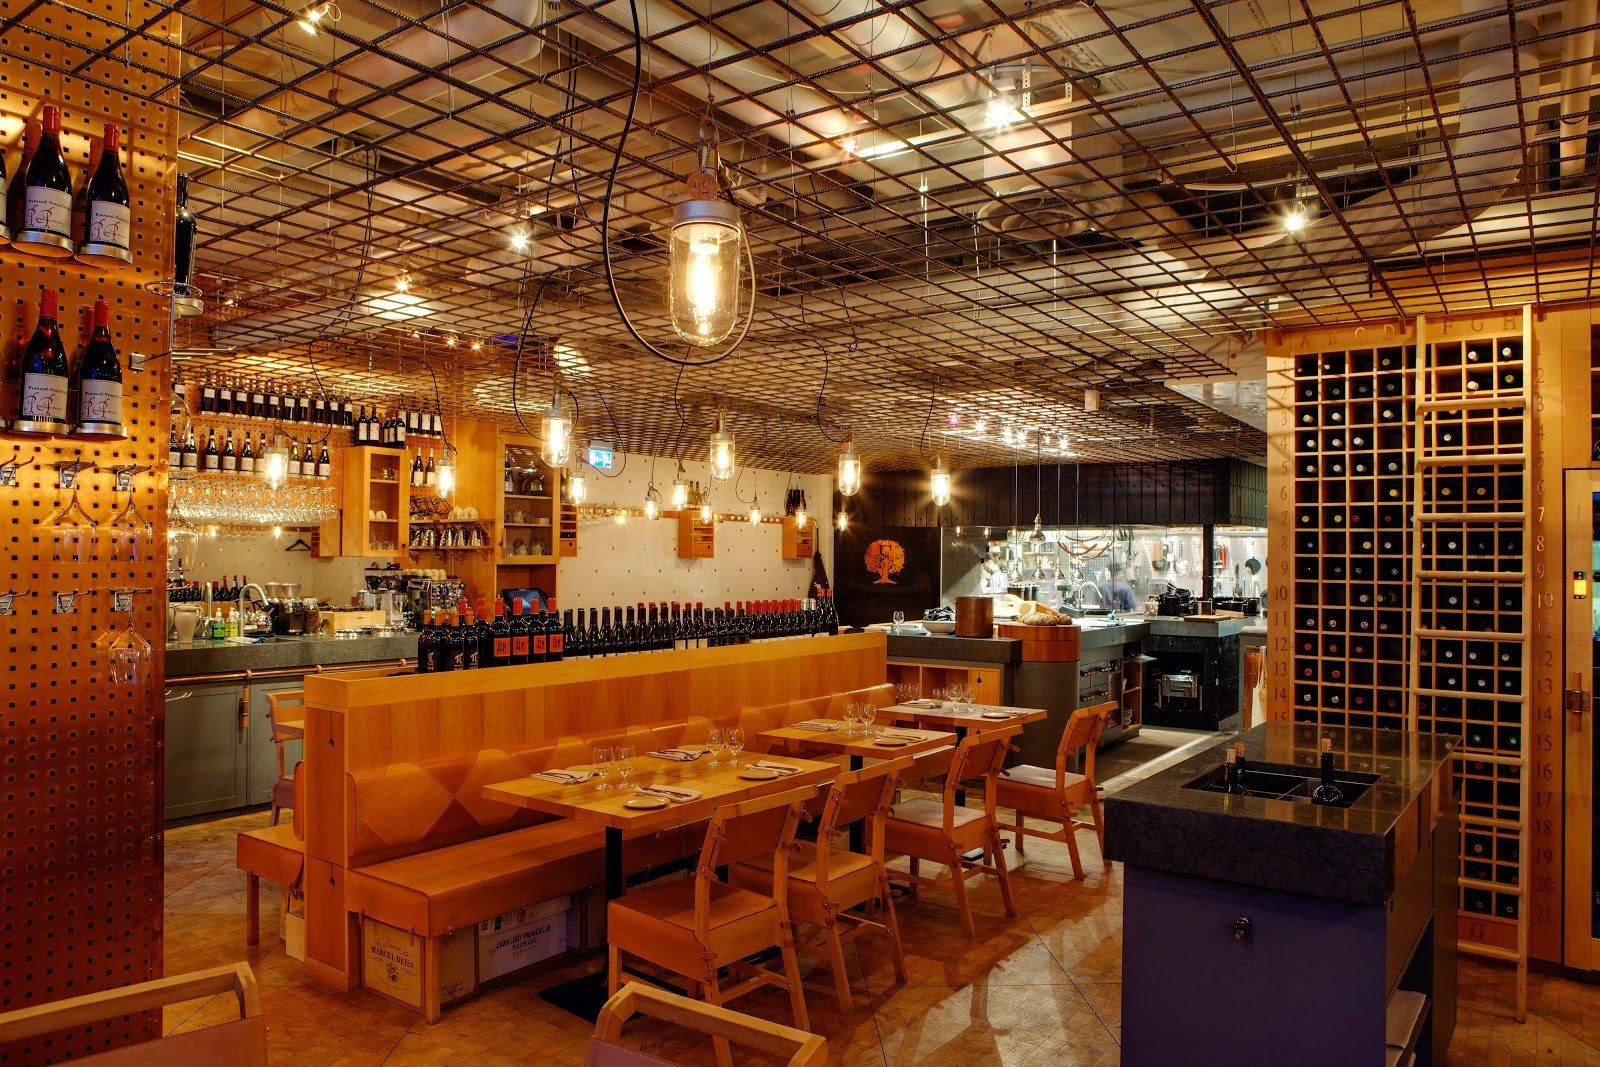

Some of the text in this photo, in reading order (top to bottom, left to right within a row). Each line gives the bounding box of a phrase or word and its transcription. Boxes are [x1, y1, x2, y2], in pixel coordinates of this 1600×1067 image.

[1354, 326, 1367, 343] C
[1383, 324, 1396, 340] D
[1471, 317, 1485, 333] G
[1536, 368, 1545, 384] 2
[1536, 396, 1544, 412] 3
[1281, 411, 1288, 426] 3
[1536, 424, 1545, 440] 4
[1280, 435, 1288, 450] 4
[1280, 460, 1288, 475] 5
[1536, 452, 1545, 468] 5
[1280, 485, 1288, 501] 6
[1536, 480, 1545, 496] 6
[1281, 510, 1288, 526] 7
[1537, 507, 1545, 523] 7
[1281, 535, 1288, 551] 8
[1536, 535, 1545, 552] 8
[1280, 560, 1289, 576] 9
[1537, 563, 1545, 580] 9
[1274, 585, 1288, 601] 10
[1537, 592, 1554, 609] 10
[1274, 611, 1288, 627] 11
[1536, 621, 1553, 639] 11
[1273, 637, 1288, 652] 12
[1536, 650, 1554, 667] 12
[1273, 661, 1288, 677] 13
[1273, 686, 1287, 702] 14
[1536, 678, 1553, 695] 13
[1537, 706, 1553, 722] 14
[1536, 734, 1553, 751] 15
[1536, 763, 1553, 780] 16
[1535, 791, 1553, 808] 17
[1536, 820, 1553, 836] 18
[1536, 848, 1553, 865] 19
[1535, 876, 1553, 895] 20
[1535, 905, 1552, 923] 21
[1470, 921, 1484, 939] G
[512, 937, 538, 951] SUEDE
[371, 945, 396, 962] MARCEL
[396, 954, 415, 969] DEISS
